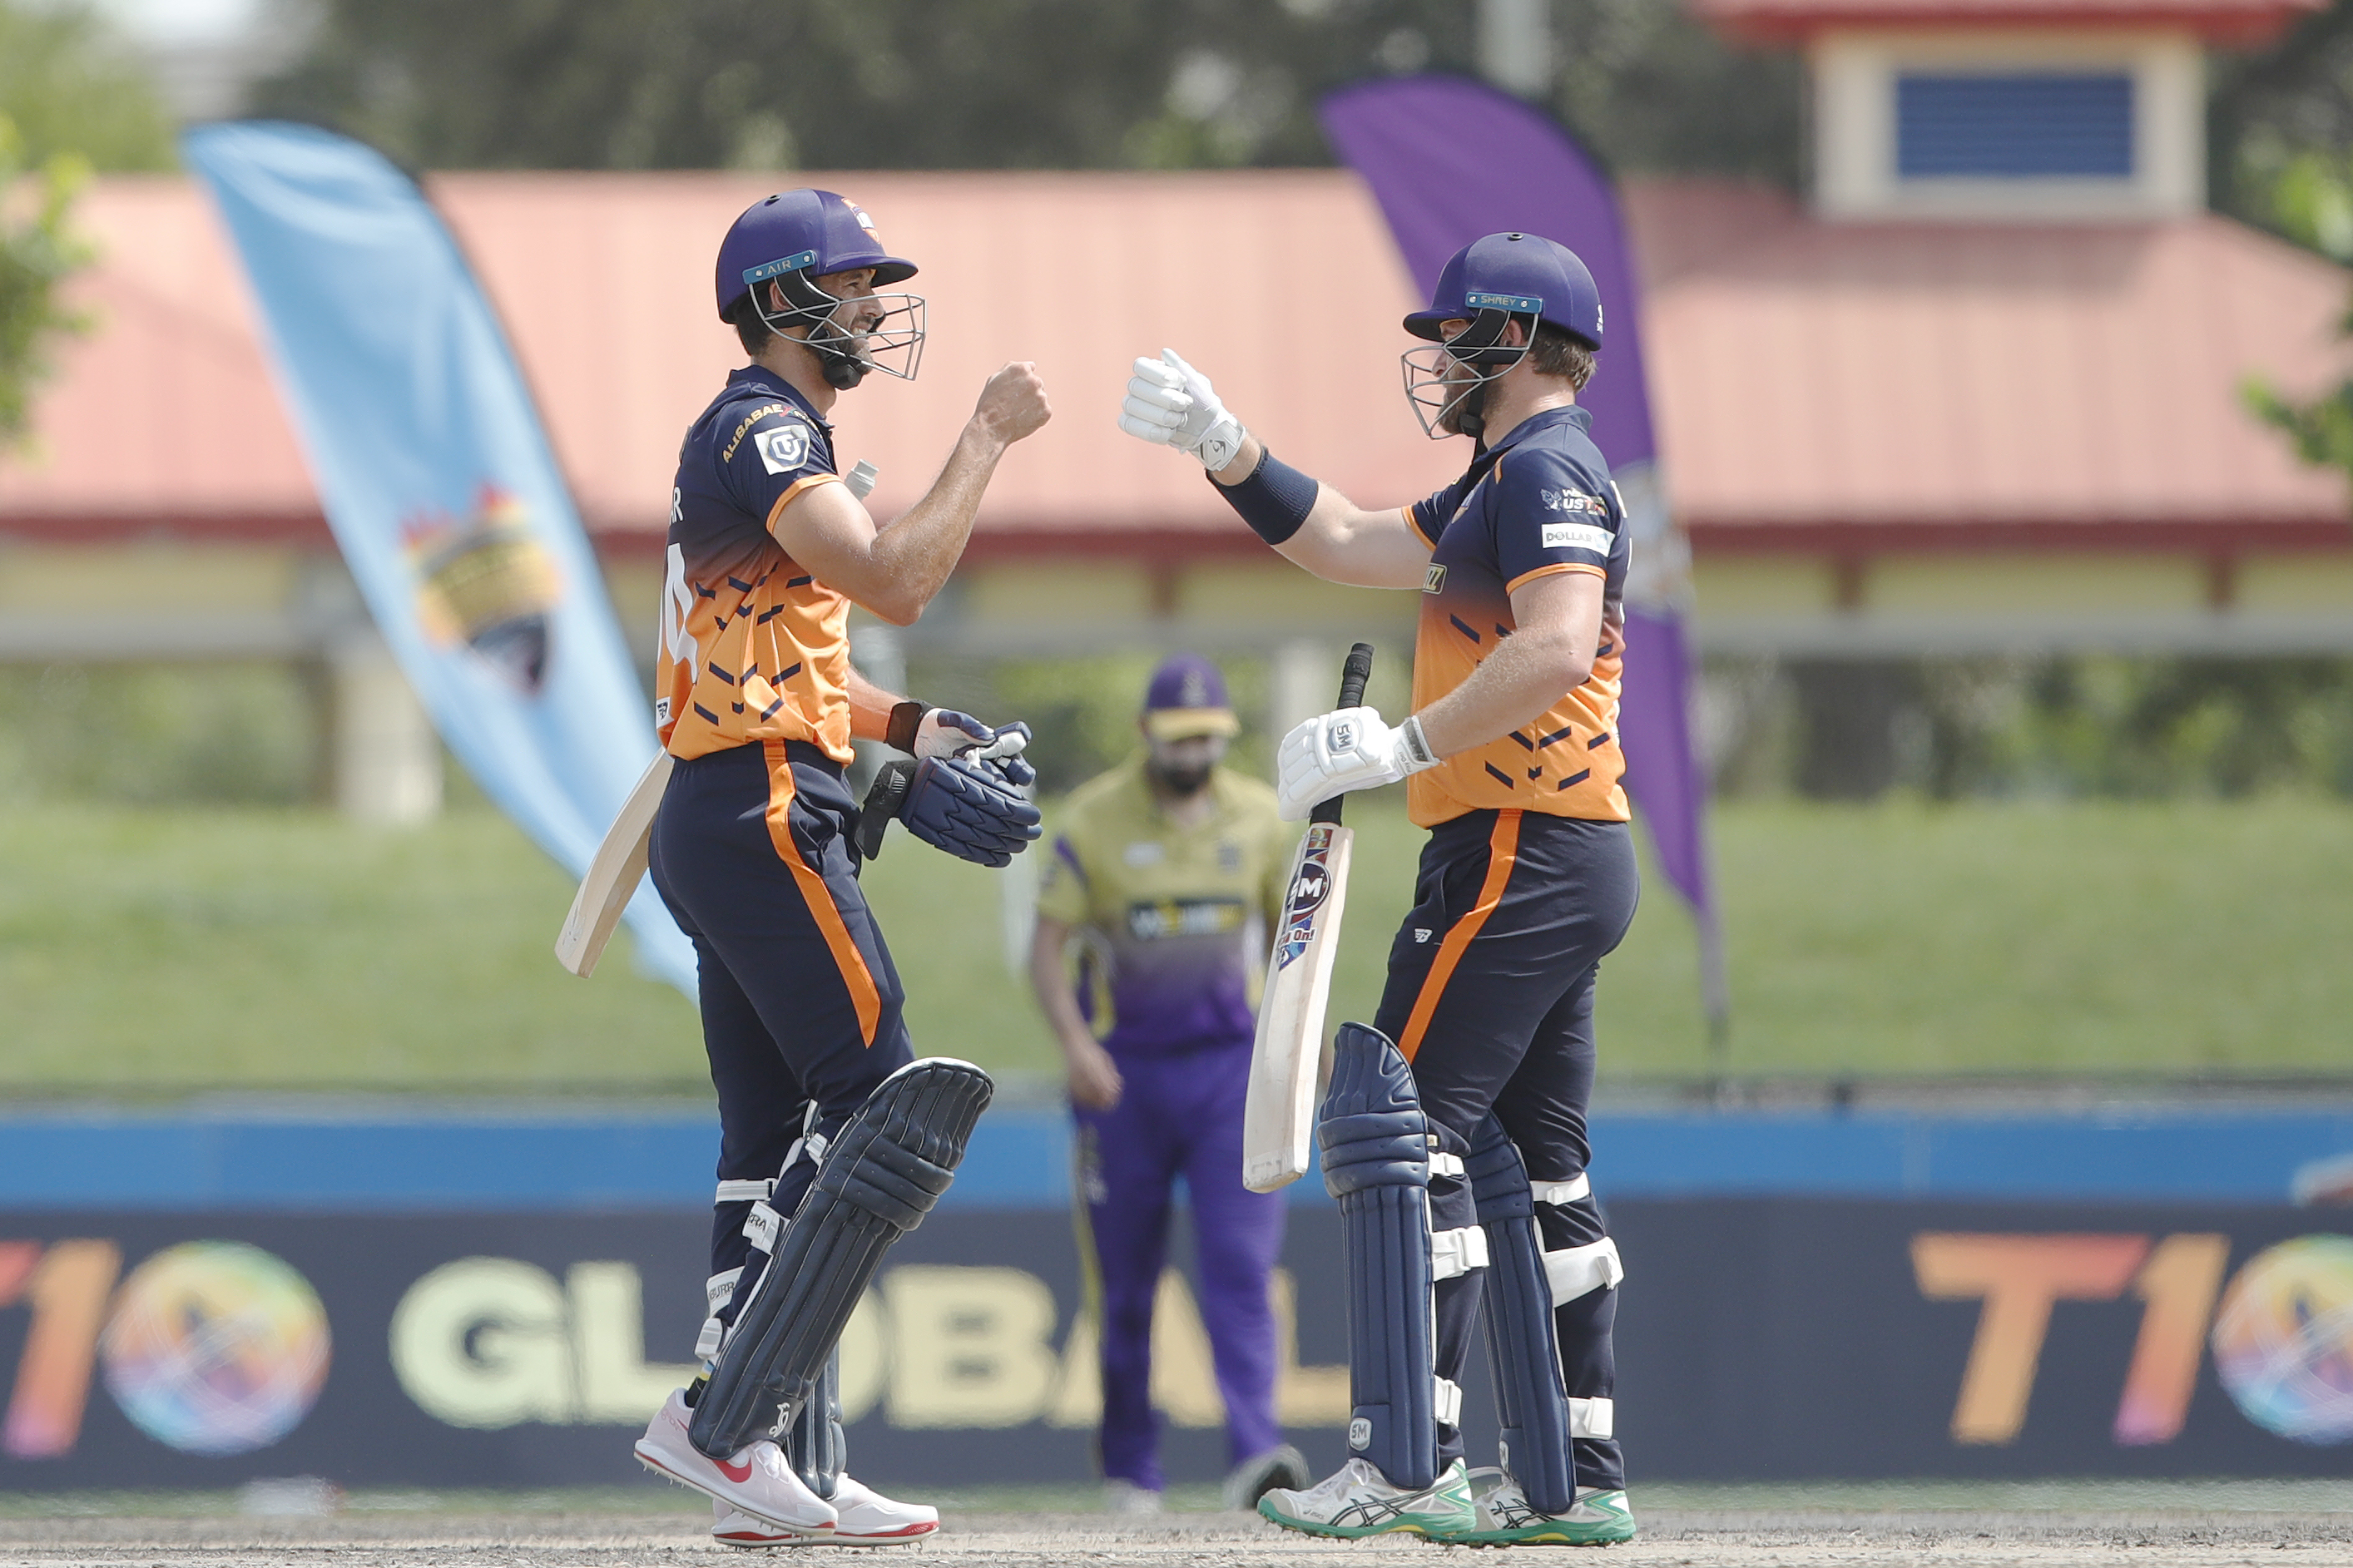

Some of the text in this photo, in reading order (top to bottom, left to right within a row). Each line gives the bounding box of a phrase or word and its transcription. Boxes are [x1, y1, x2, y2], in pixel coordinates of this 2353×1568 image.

[767, 260, 791, 275] AIR
[1480, 295, 1517, 306] SHREY
[1546, 532, 1593, 542] DOLLAR
[1294, 928, 1315, 941] On!
[0, 1239, 1350, 1457] 10 GLBAL
[1351, 1423, 1368, 1439] SM
